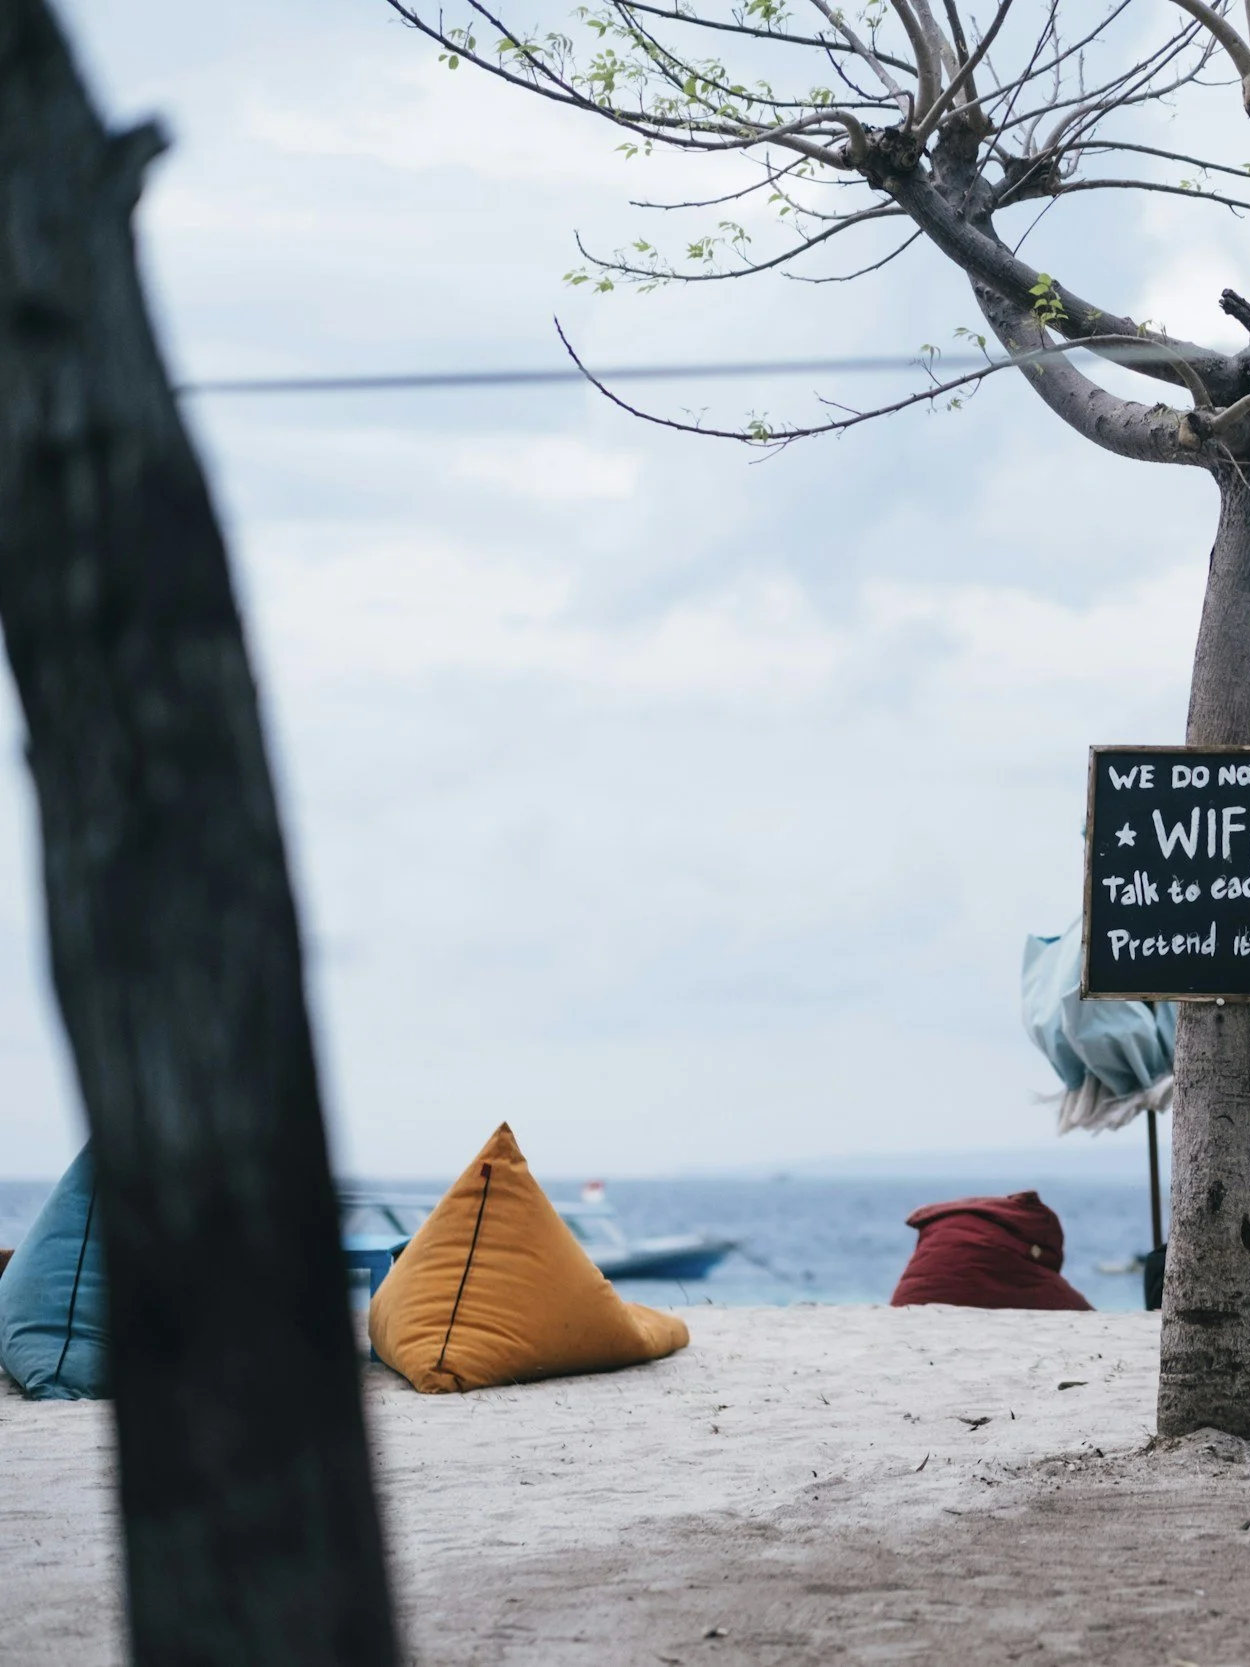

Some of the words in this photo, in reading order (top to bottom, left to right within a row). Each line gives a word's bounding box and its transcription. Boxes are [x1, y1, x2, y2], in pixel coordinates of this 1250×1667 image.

[1108, 765, 1155, 790] WE
[1172, 765, 1210, 789] DO
[1102, 869, 1159, 906] Talk
[1167, 876, 1201, 904] to
[1107, 920, 1216, 961] Pretend
